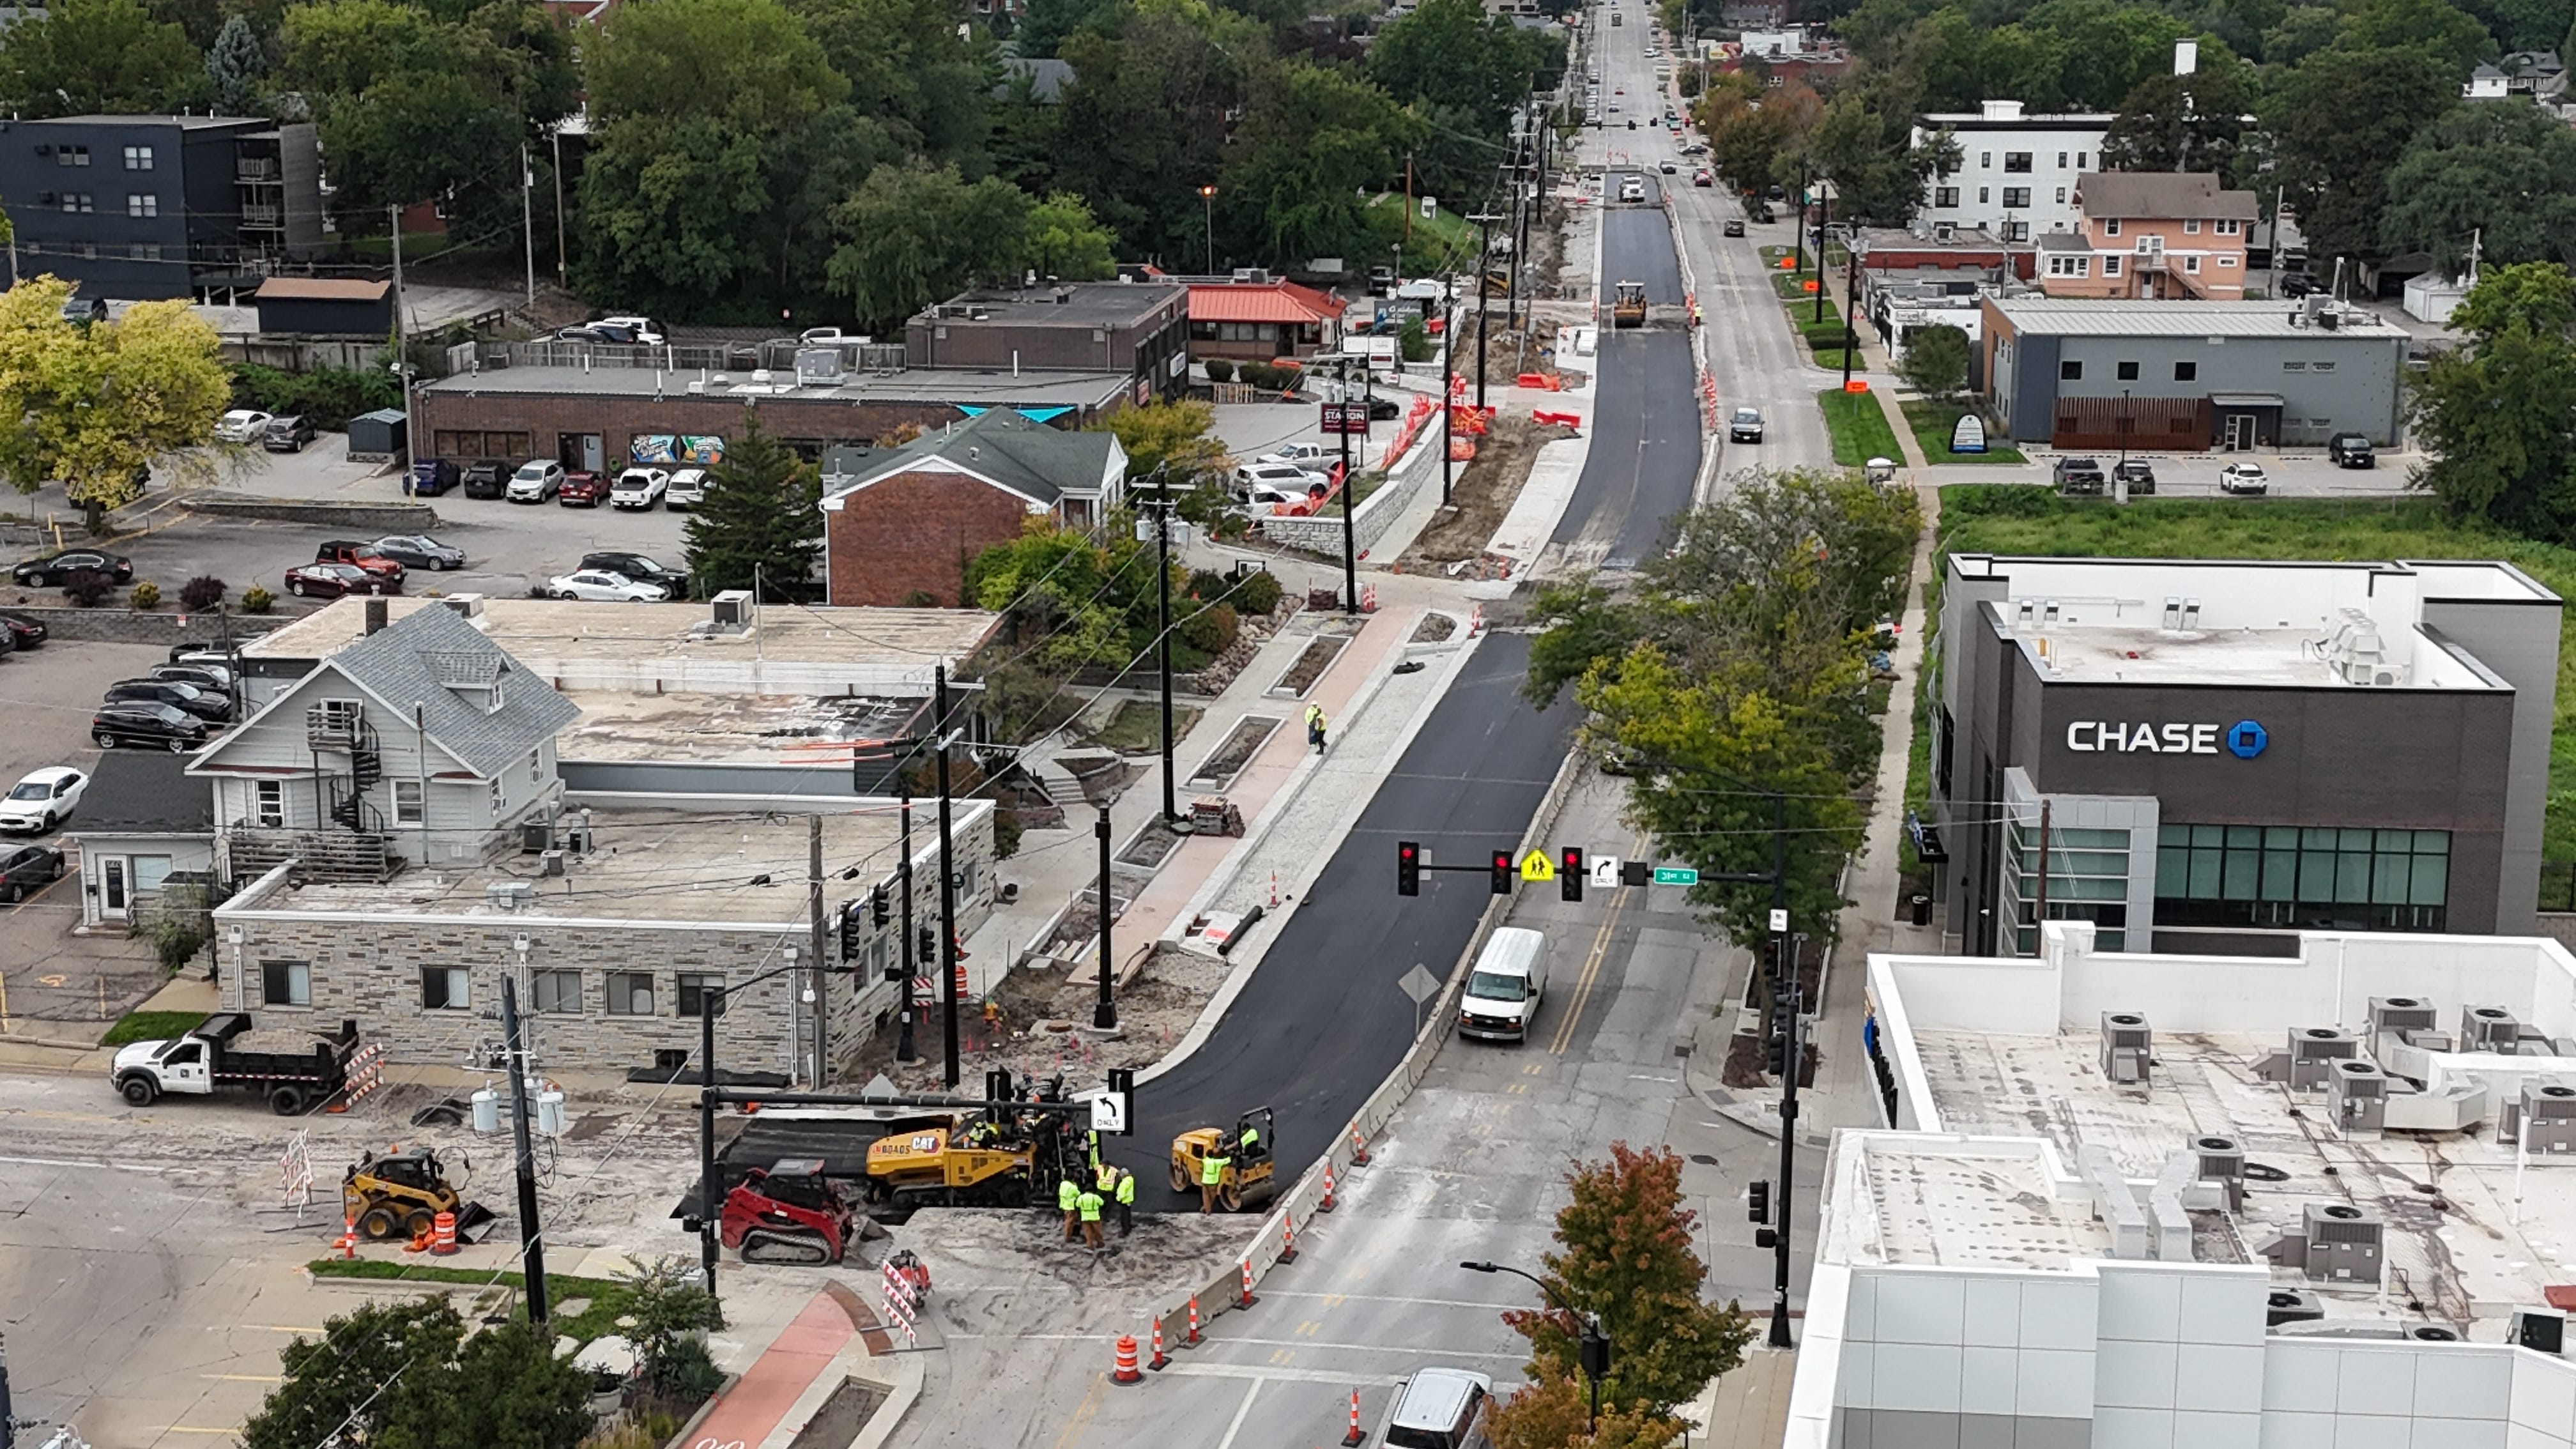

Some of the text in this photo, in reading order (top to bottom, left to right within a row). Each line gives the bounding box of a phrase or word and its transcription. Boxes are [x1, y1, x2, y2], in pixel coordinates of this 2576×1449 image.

[1324, 410, 1365, 420] STAION
[2067, 721, 2220, 753] CHASE
[912, 1137, 935, 1150] CAT
